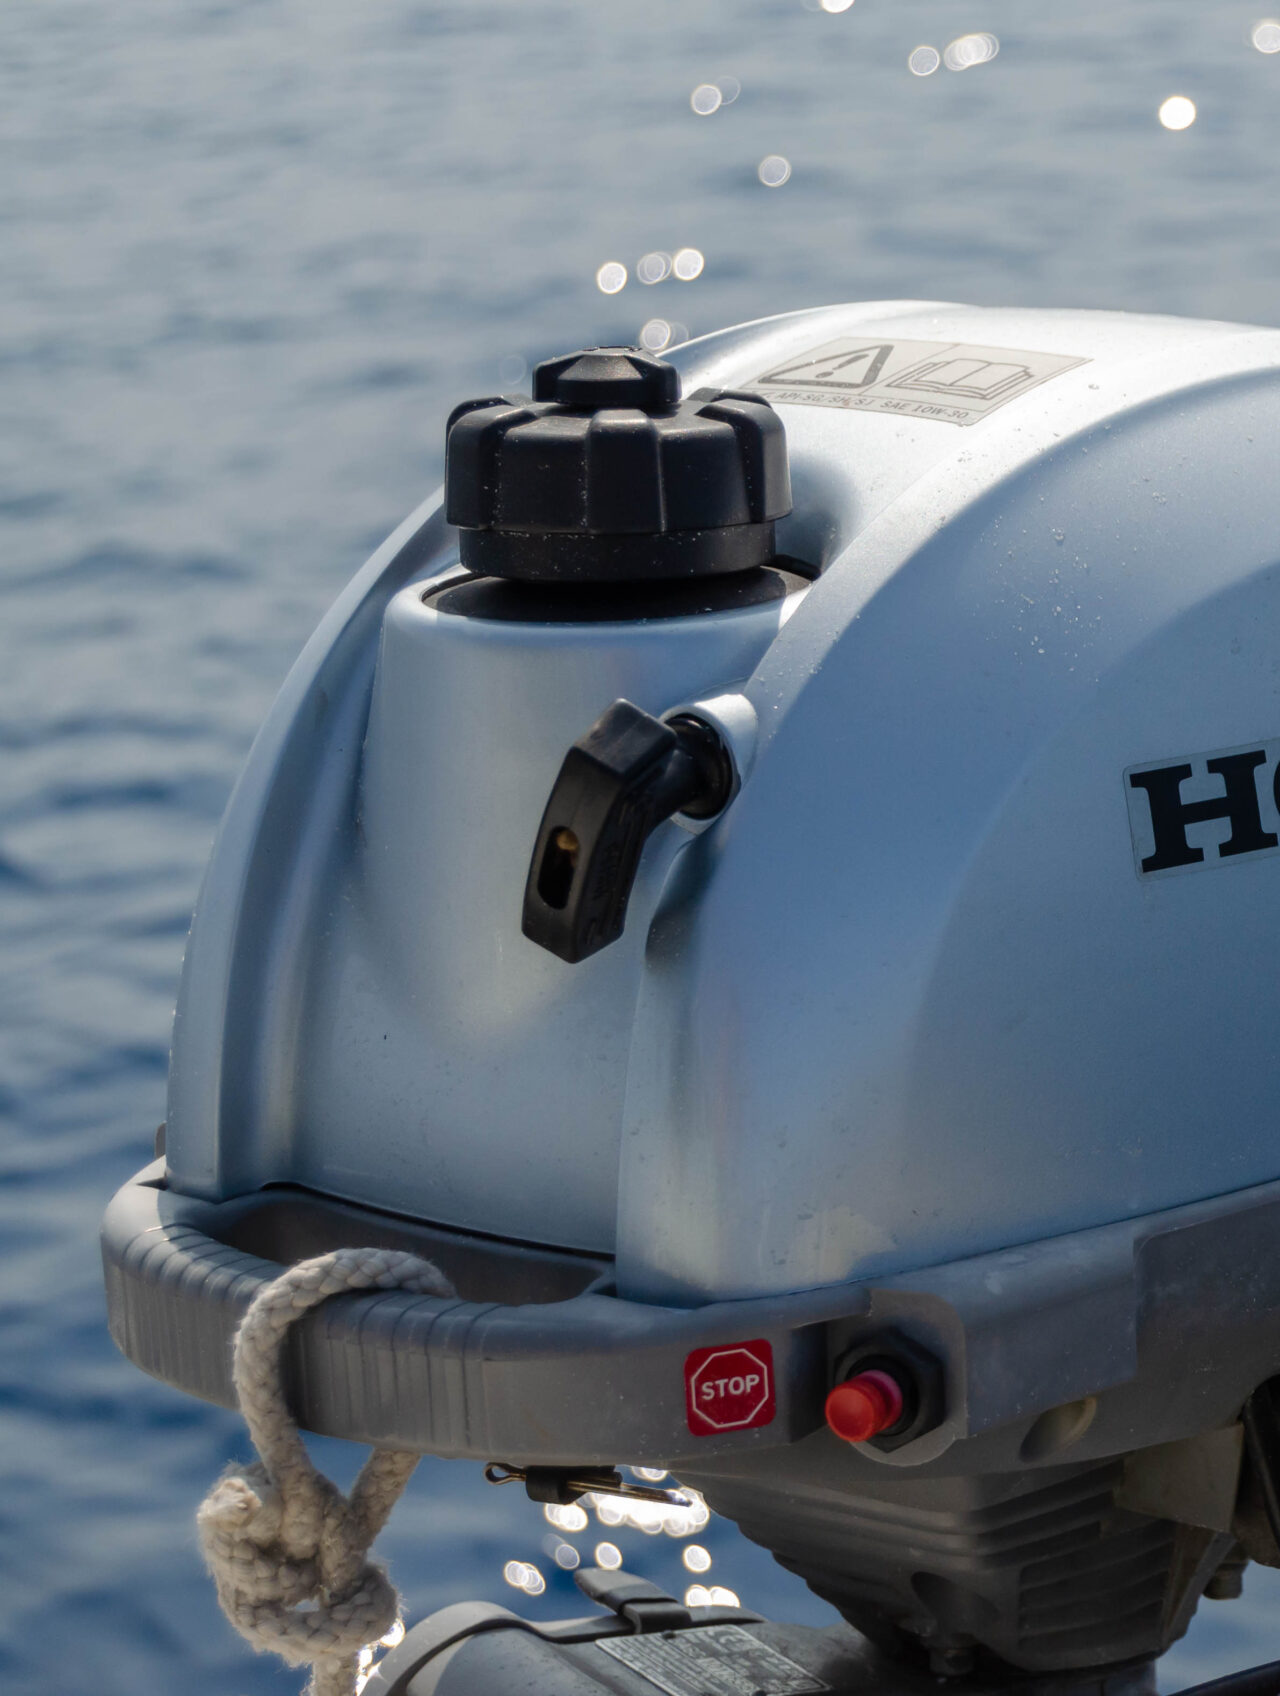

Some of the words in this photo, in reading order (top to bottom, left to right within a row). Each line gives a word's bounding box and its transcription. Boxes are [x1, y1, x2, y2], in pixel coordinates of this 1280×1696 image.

[880, 400, 912, 410] SAE
[912, 404, 969, 419] 10W-30
[701, 1374, 760, 1400] STOP
